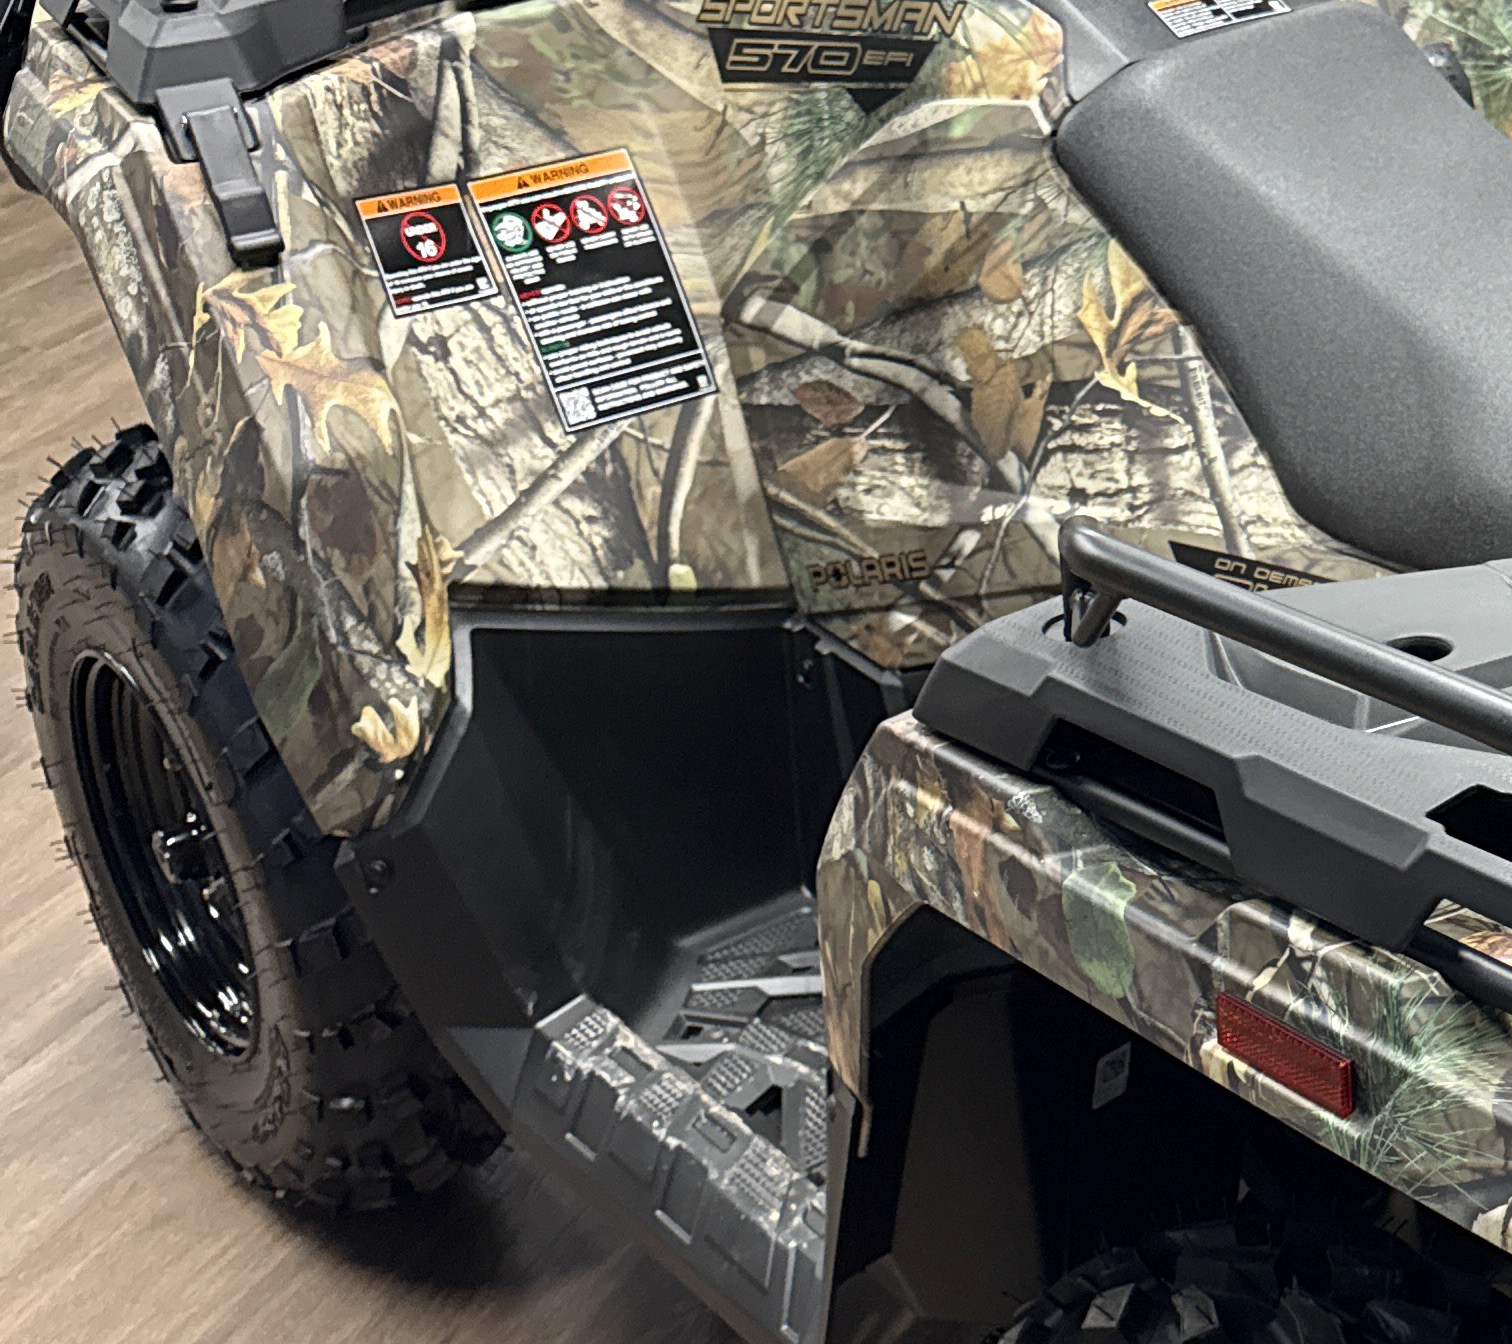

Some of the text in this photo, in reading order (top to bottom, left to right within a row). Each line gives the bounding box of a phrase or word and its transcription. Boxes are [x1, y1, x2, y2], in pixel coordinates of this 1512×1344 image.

[725, 38, 915, 76] 570 EFI
[529, 163, 590, 185] WARNING
[386, 192, 441, 209] WARNING
[416, 238, 438, 258] 16
[807, 549, 930, 592] POLARIS
[1213, 557, 1247, 575] ON
